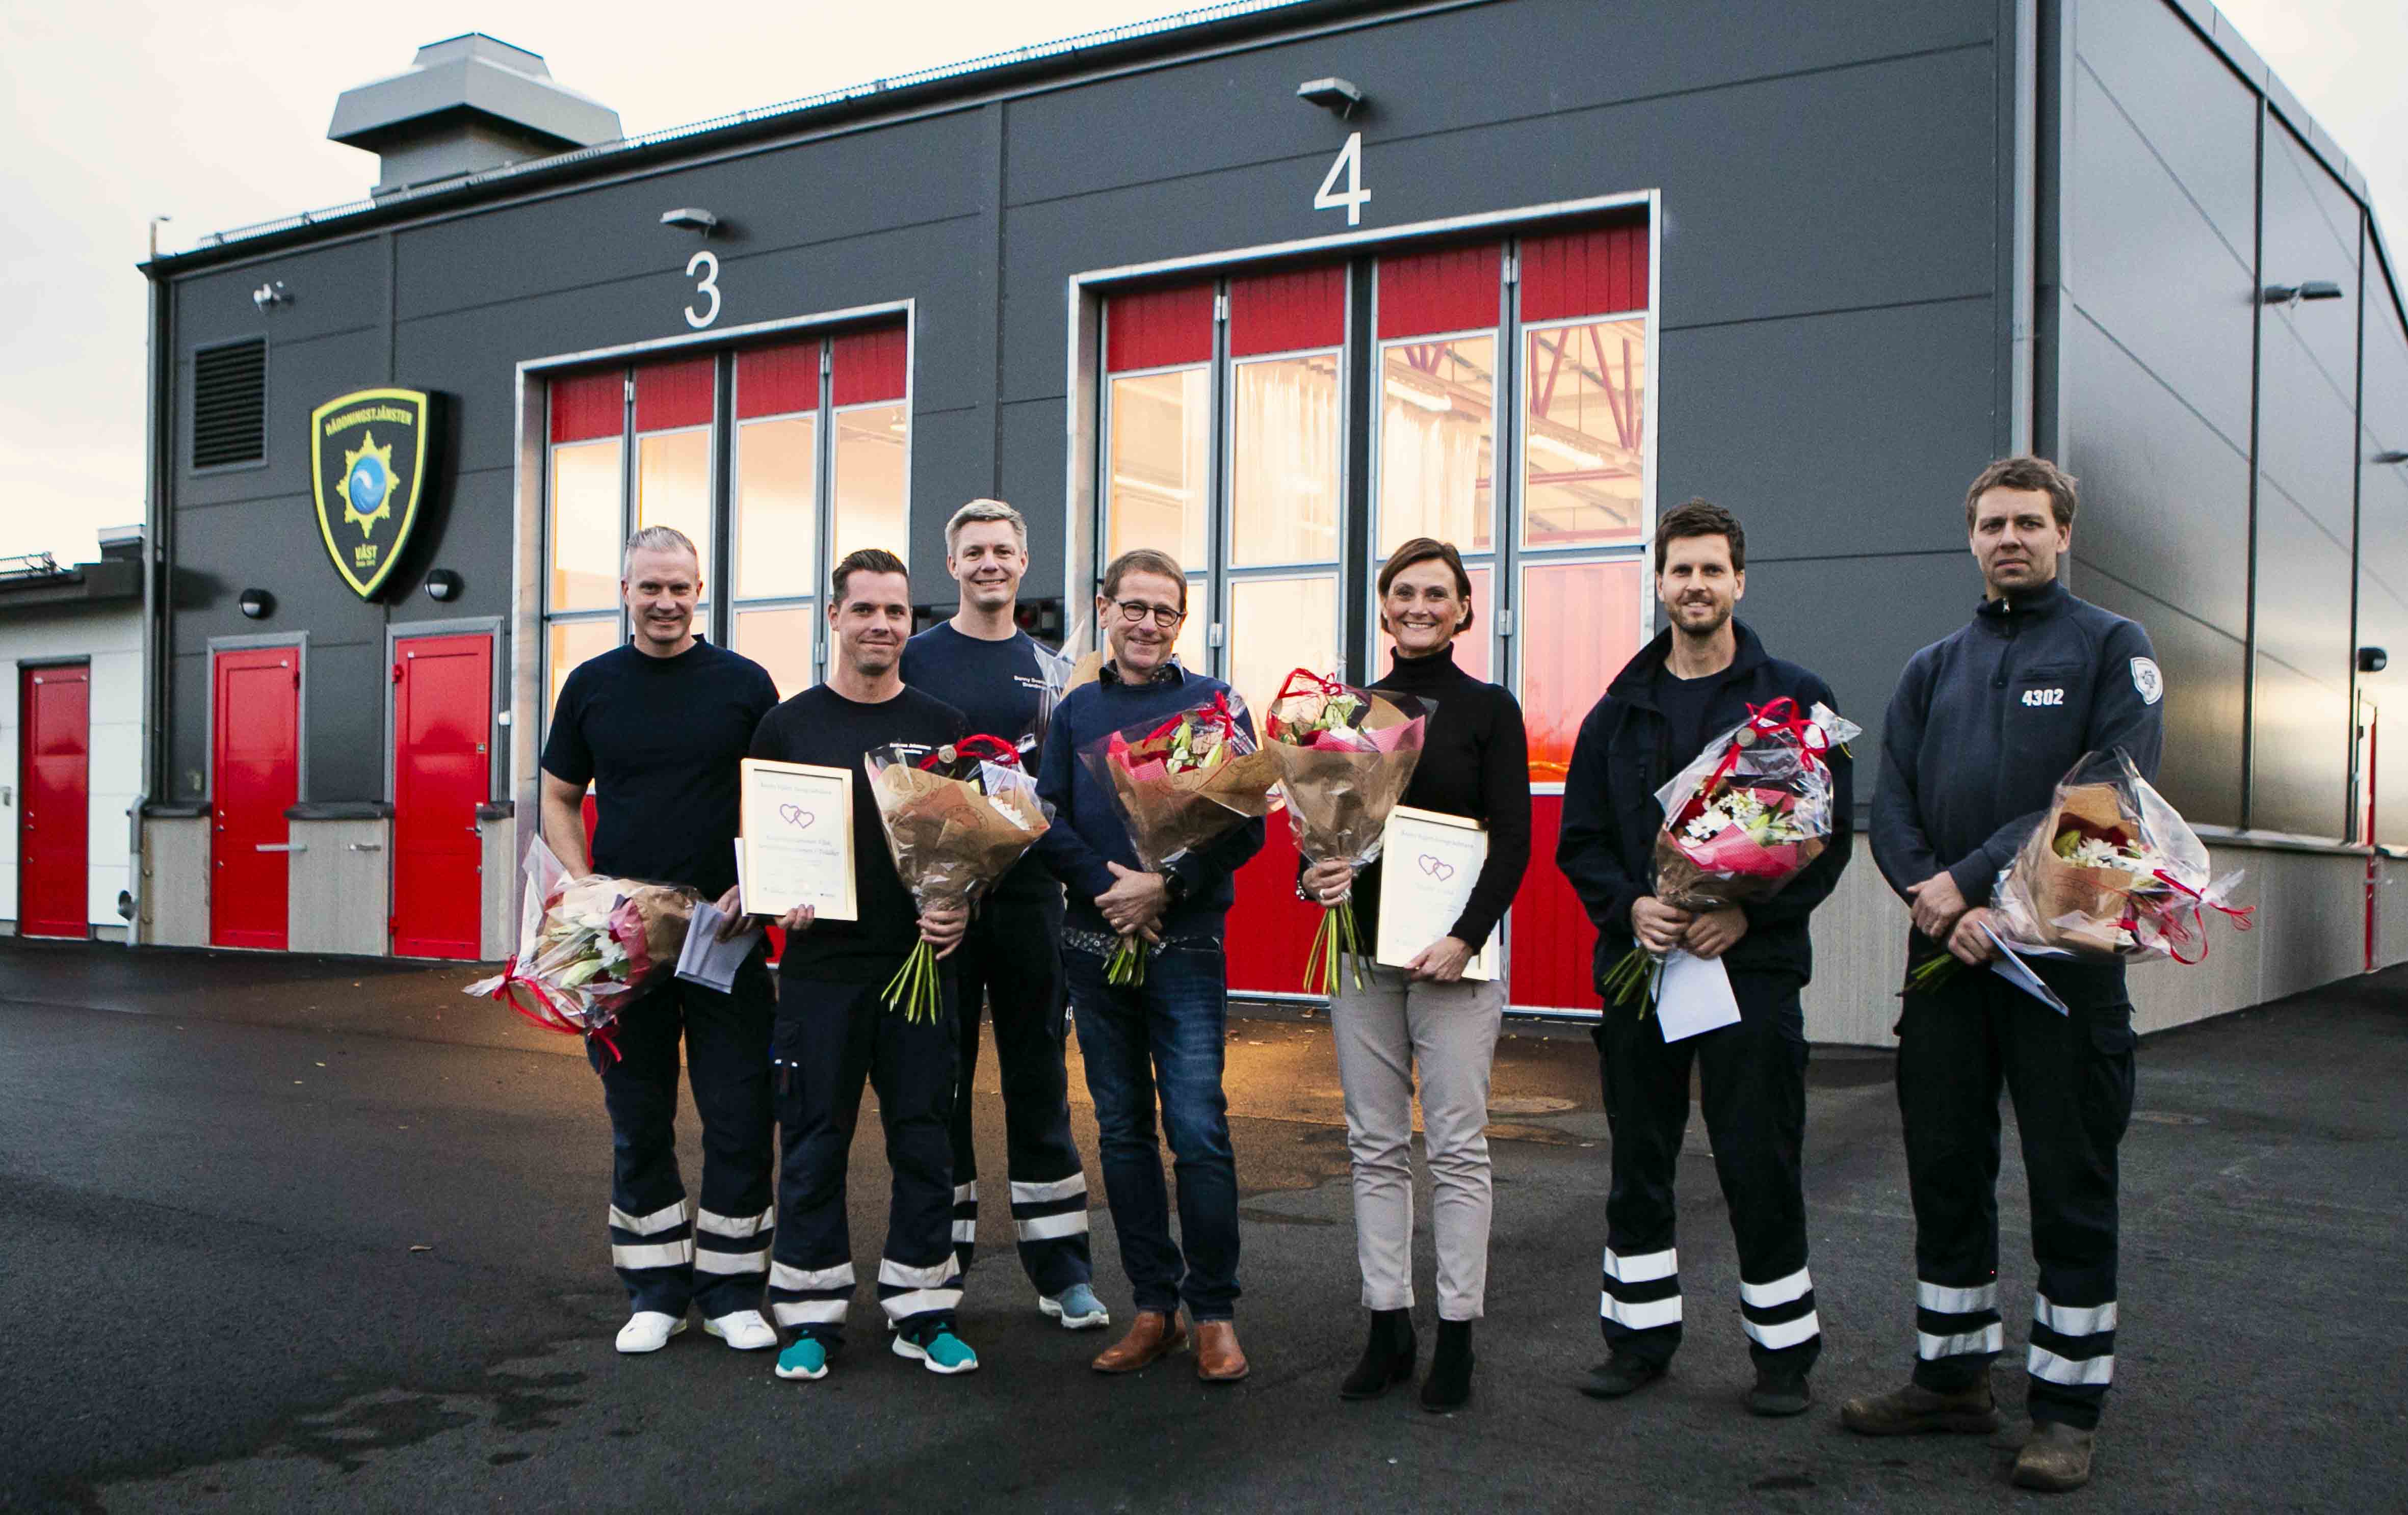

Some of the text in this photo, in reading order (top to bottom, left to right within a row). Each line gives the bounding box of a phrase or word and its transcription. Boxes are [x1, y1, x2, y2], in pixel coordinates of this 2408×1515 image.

[1314, 131, 1371, 226] 4
[684, 251, 721, 328] 3
[2022, 688, 2064, 706] 4302
